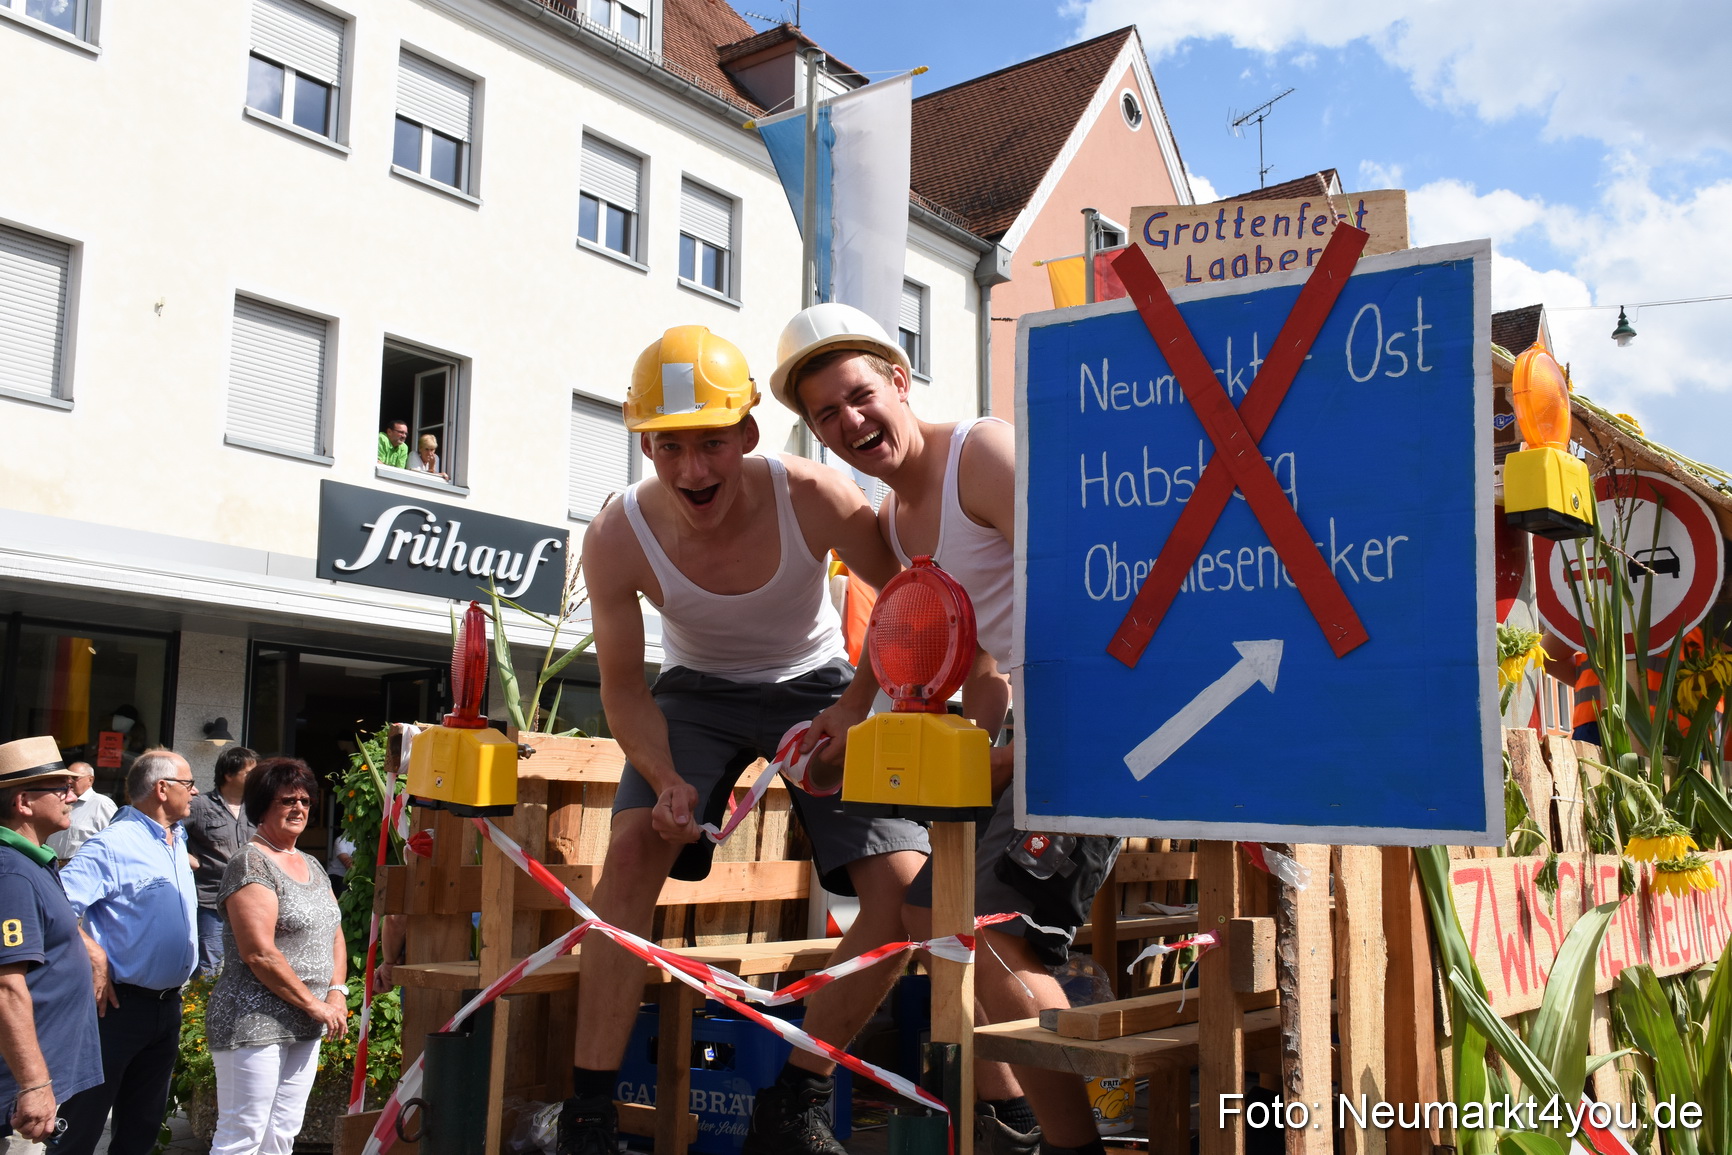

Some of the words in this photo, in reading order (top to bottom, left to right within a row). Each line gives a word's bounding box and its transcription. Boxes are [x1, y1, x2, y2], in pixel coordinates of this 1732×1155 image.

[1185, 244, 1323, 284] Laaber
[1080, 331, 1264, 413] Neumkt
[1345, 296, 1433, 383] Ost
[334, 504, 562, 599] frühauf
[2, 918, 24, 947] 8
